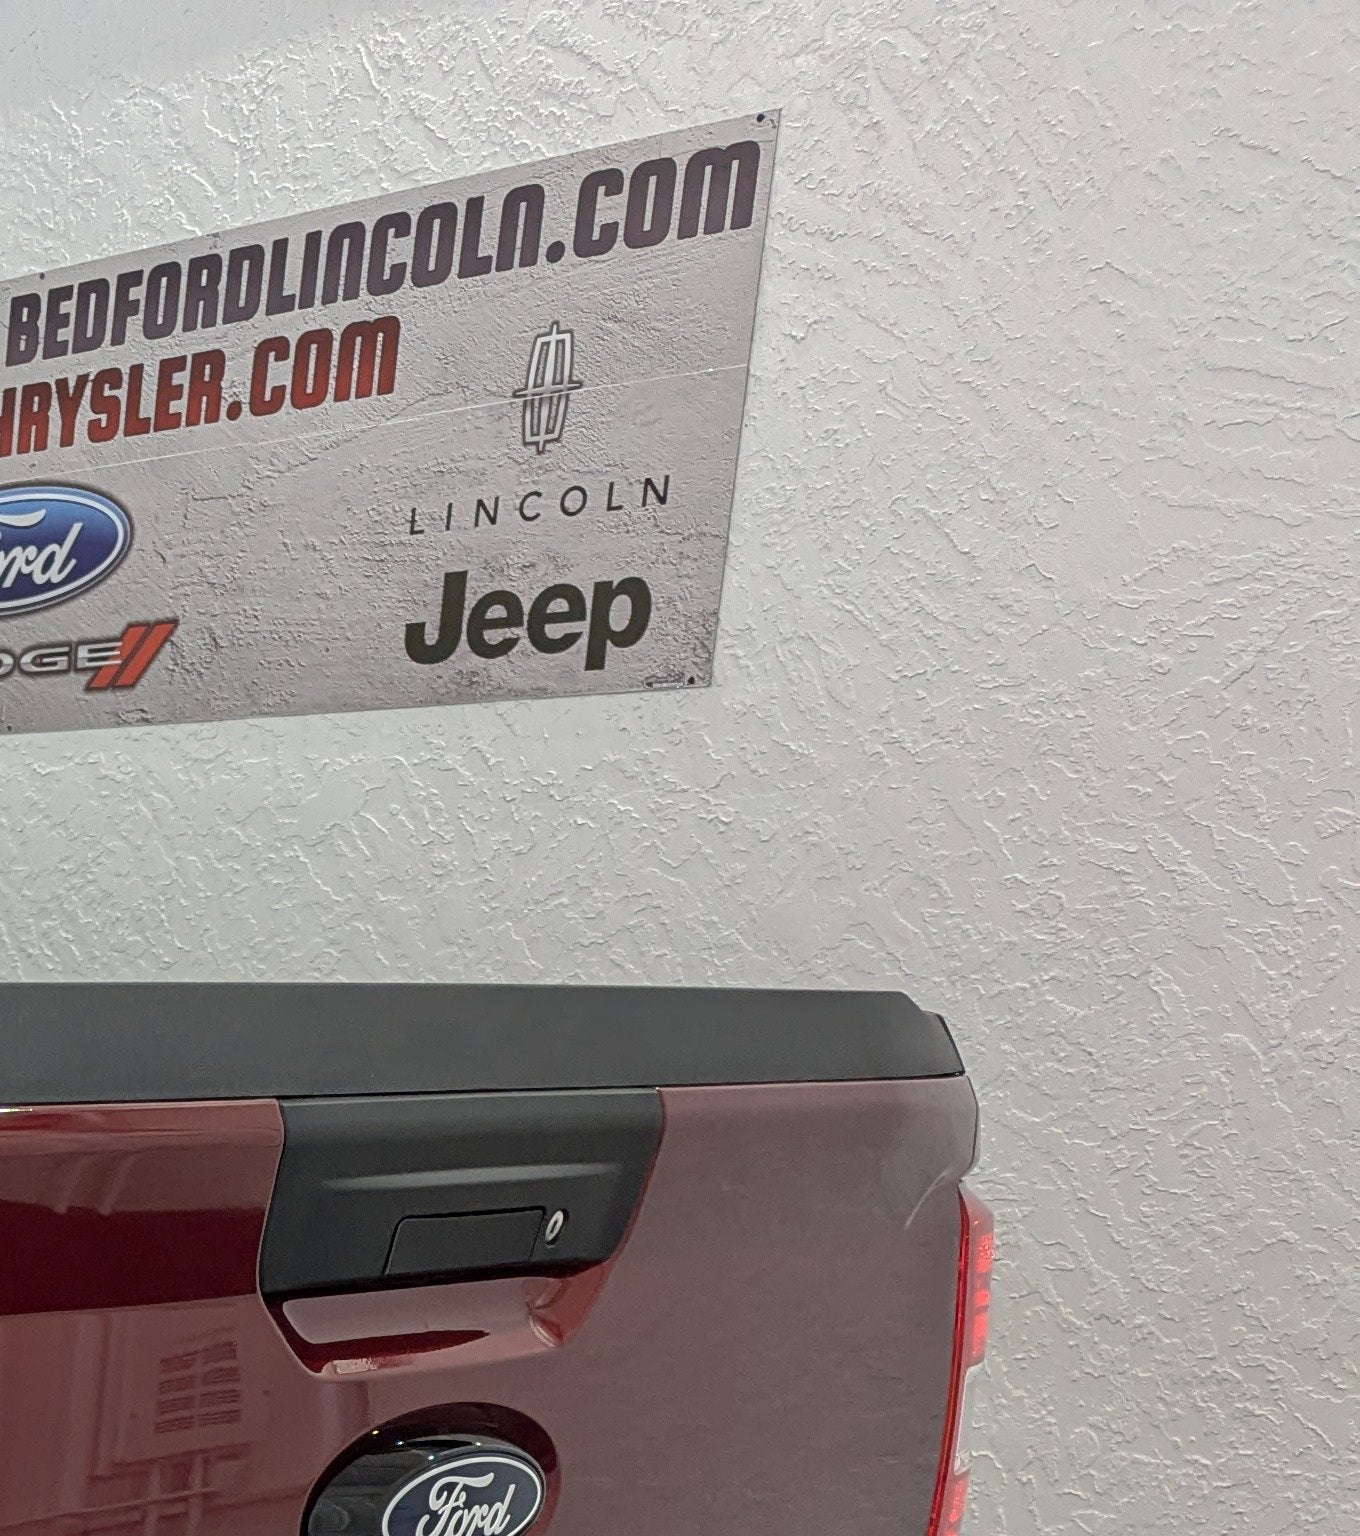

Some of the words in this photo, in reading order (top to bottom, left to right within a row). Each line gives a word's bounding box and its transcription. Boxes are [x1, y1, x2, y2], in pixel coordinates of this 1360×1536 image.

[7, 140, 762, 366] BEDFORDLINCOLN.COM
[409, 474, 671, 535] LINCOLN
[405, 570, 651, 670] Jeep
